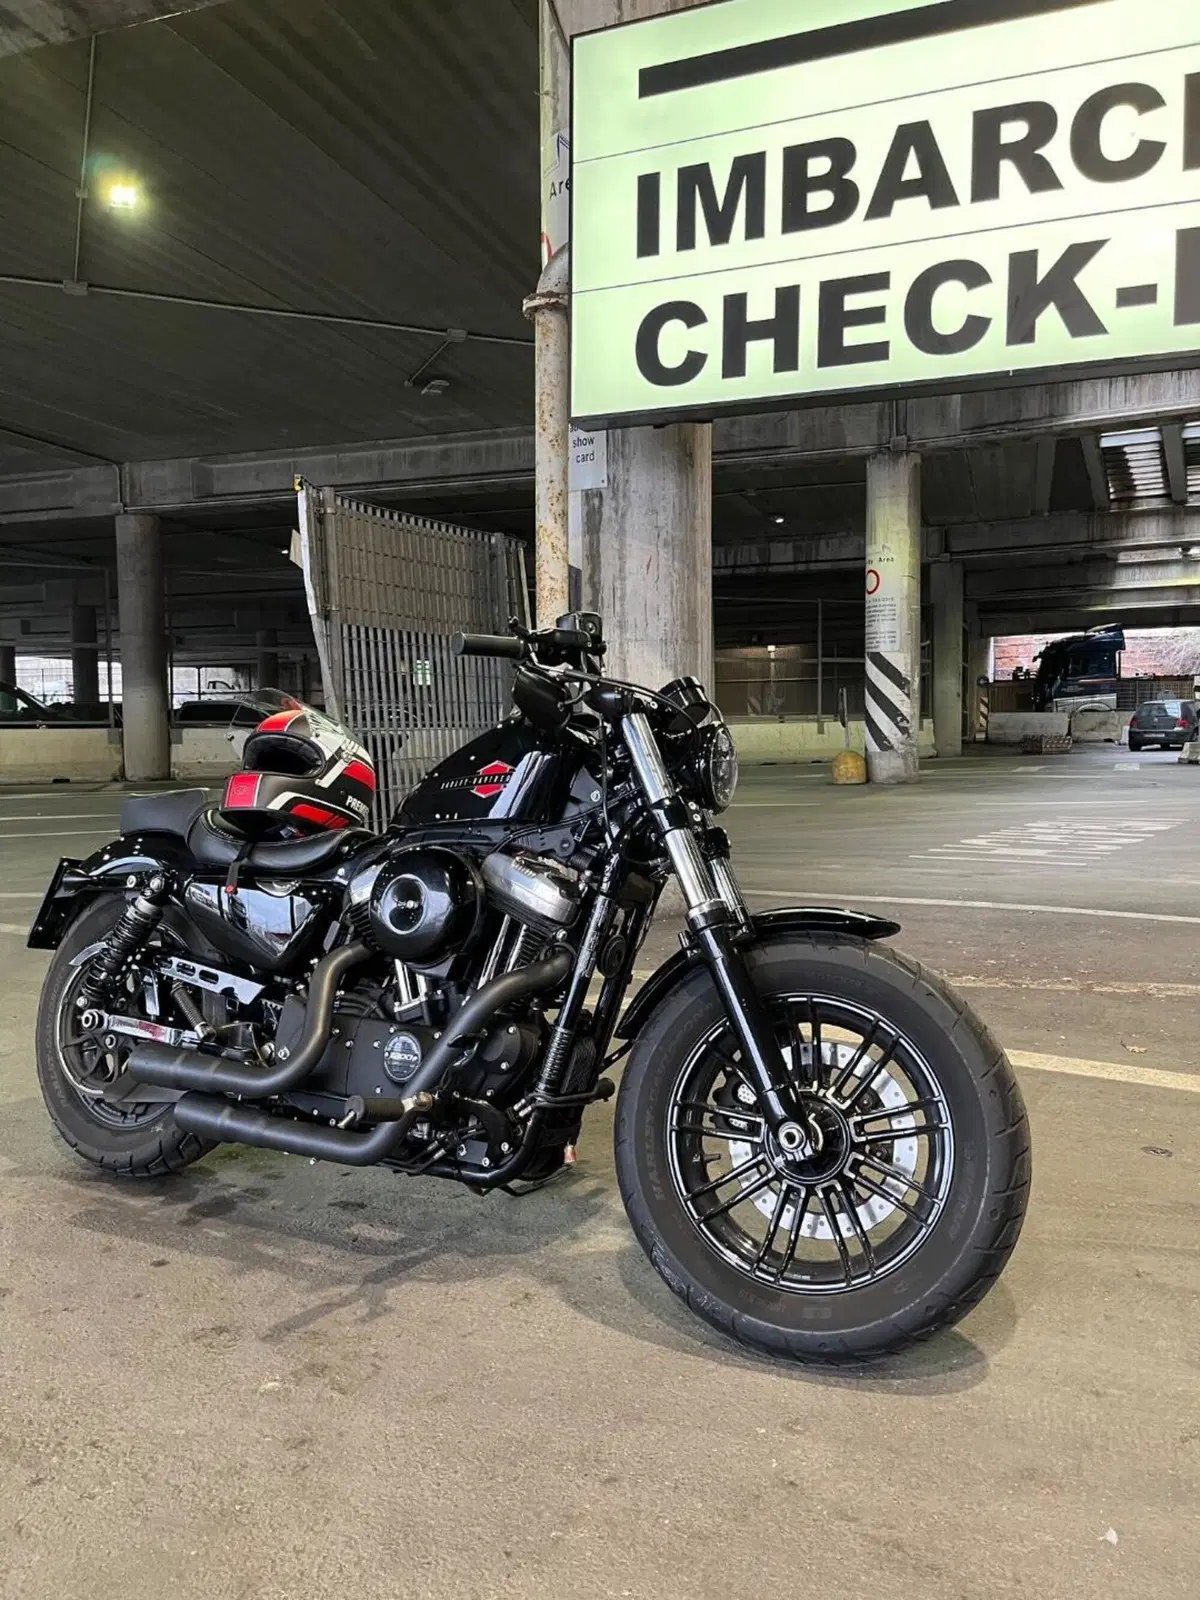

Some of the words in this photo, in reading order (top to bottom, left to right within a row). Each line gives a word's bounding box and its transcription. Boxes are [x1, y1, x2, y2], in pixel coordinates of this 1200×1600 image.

[636, 72, 1200, 258] IMBARC
[550, 178, 570, 200] Are
[572, 436, 595, 448] show
[576, 451, 595, 463] card
